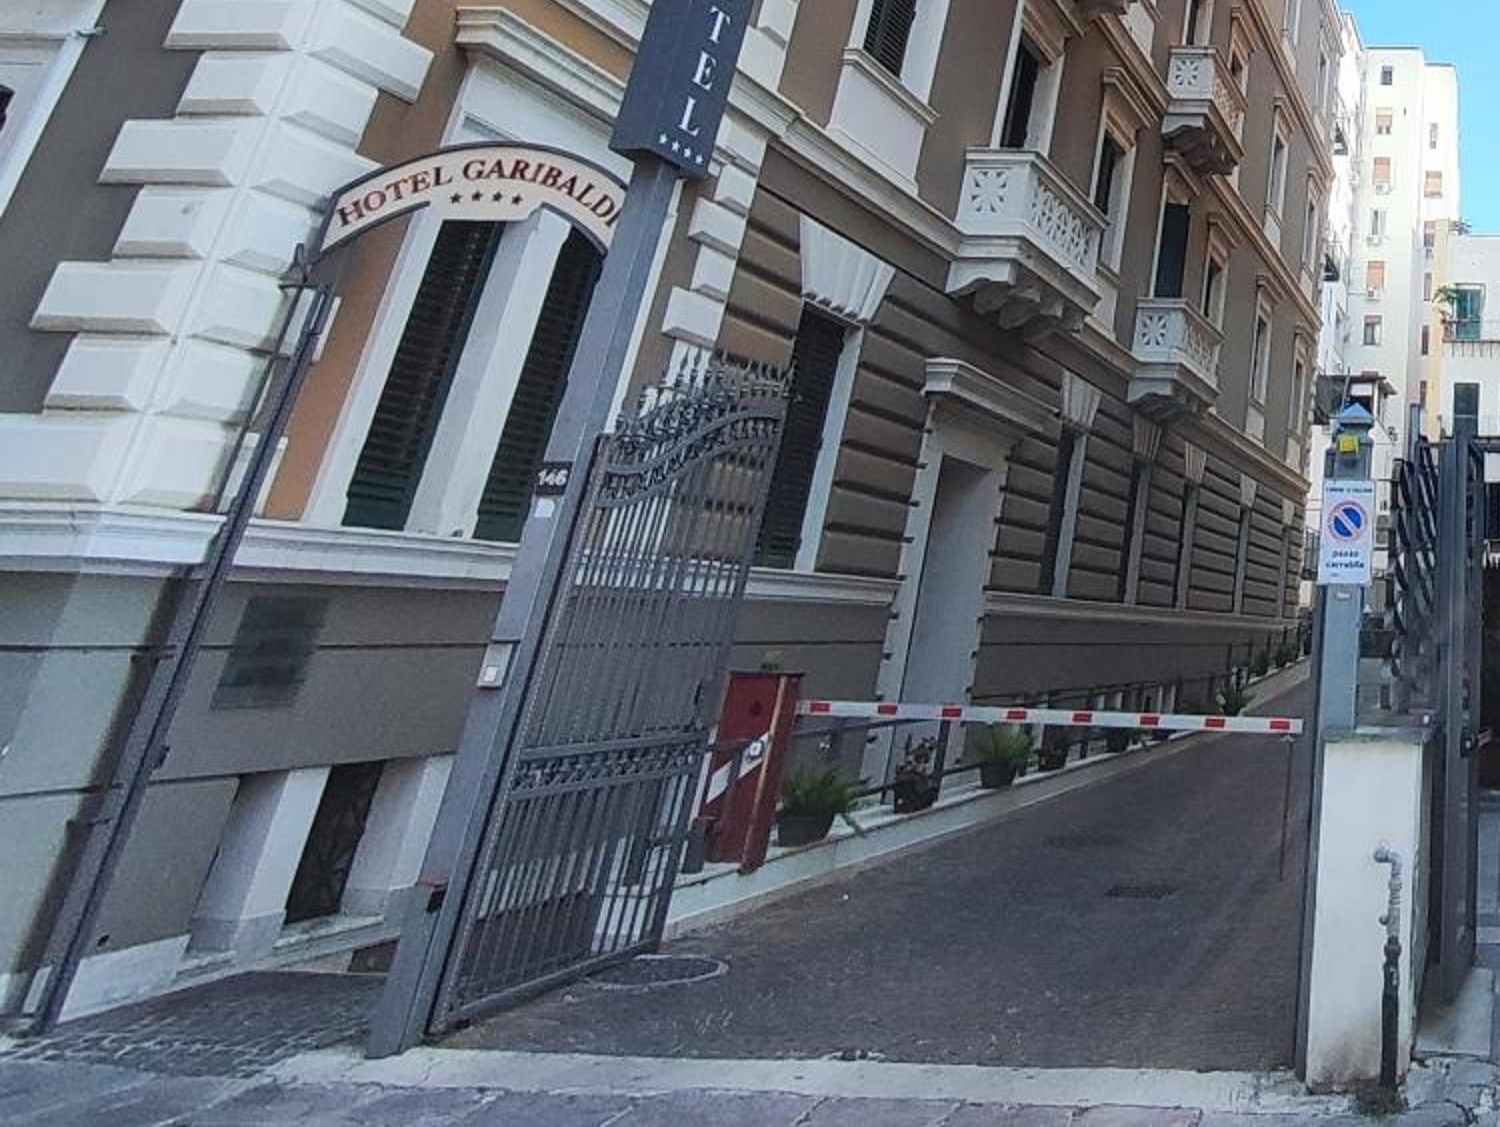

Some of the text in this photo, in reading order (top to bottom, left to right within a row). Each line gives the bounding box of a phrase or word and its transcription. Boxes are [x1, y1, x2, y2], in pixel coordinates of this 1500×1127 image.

[337, 159, 623, 228] HOTEL GARIBALDI
[537, 468, 569, 486] 146
